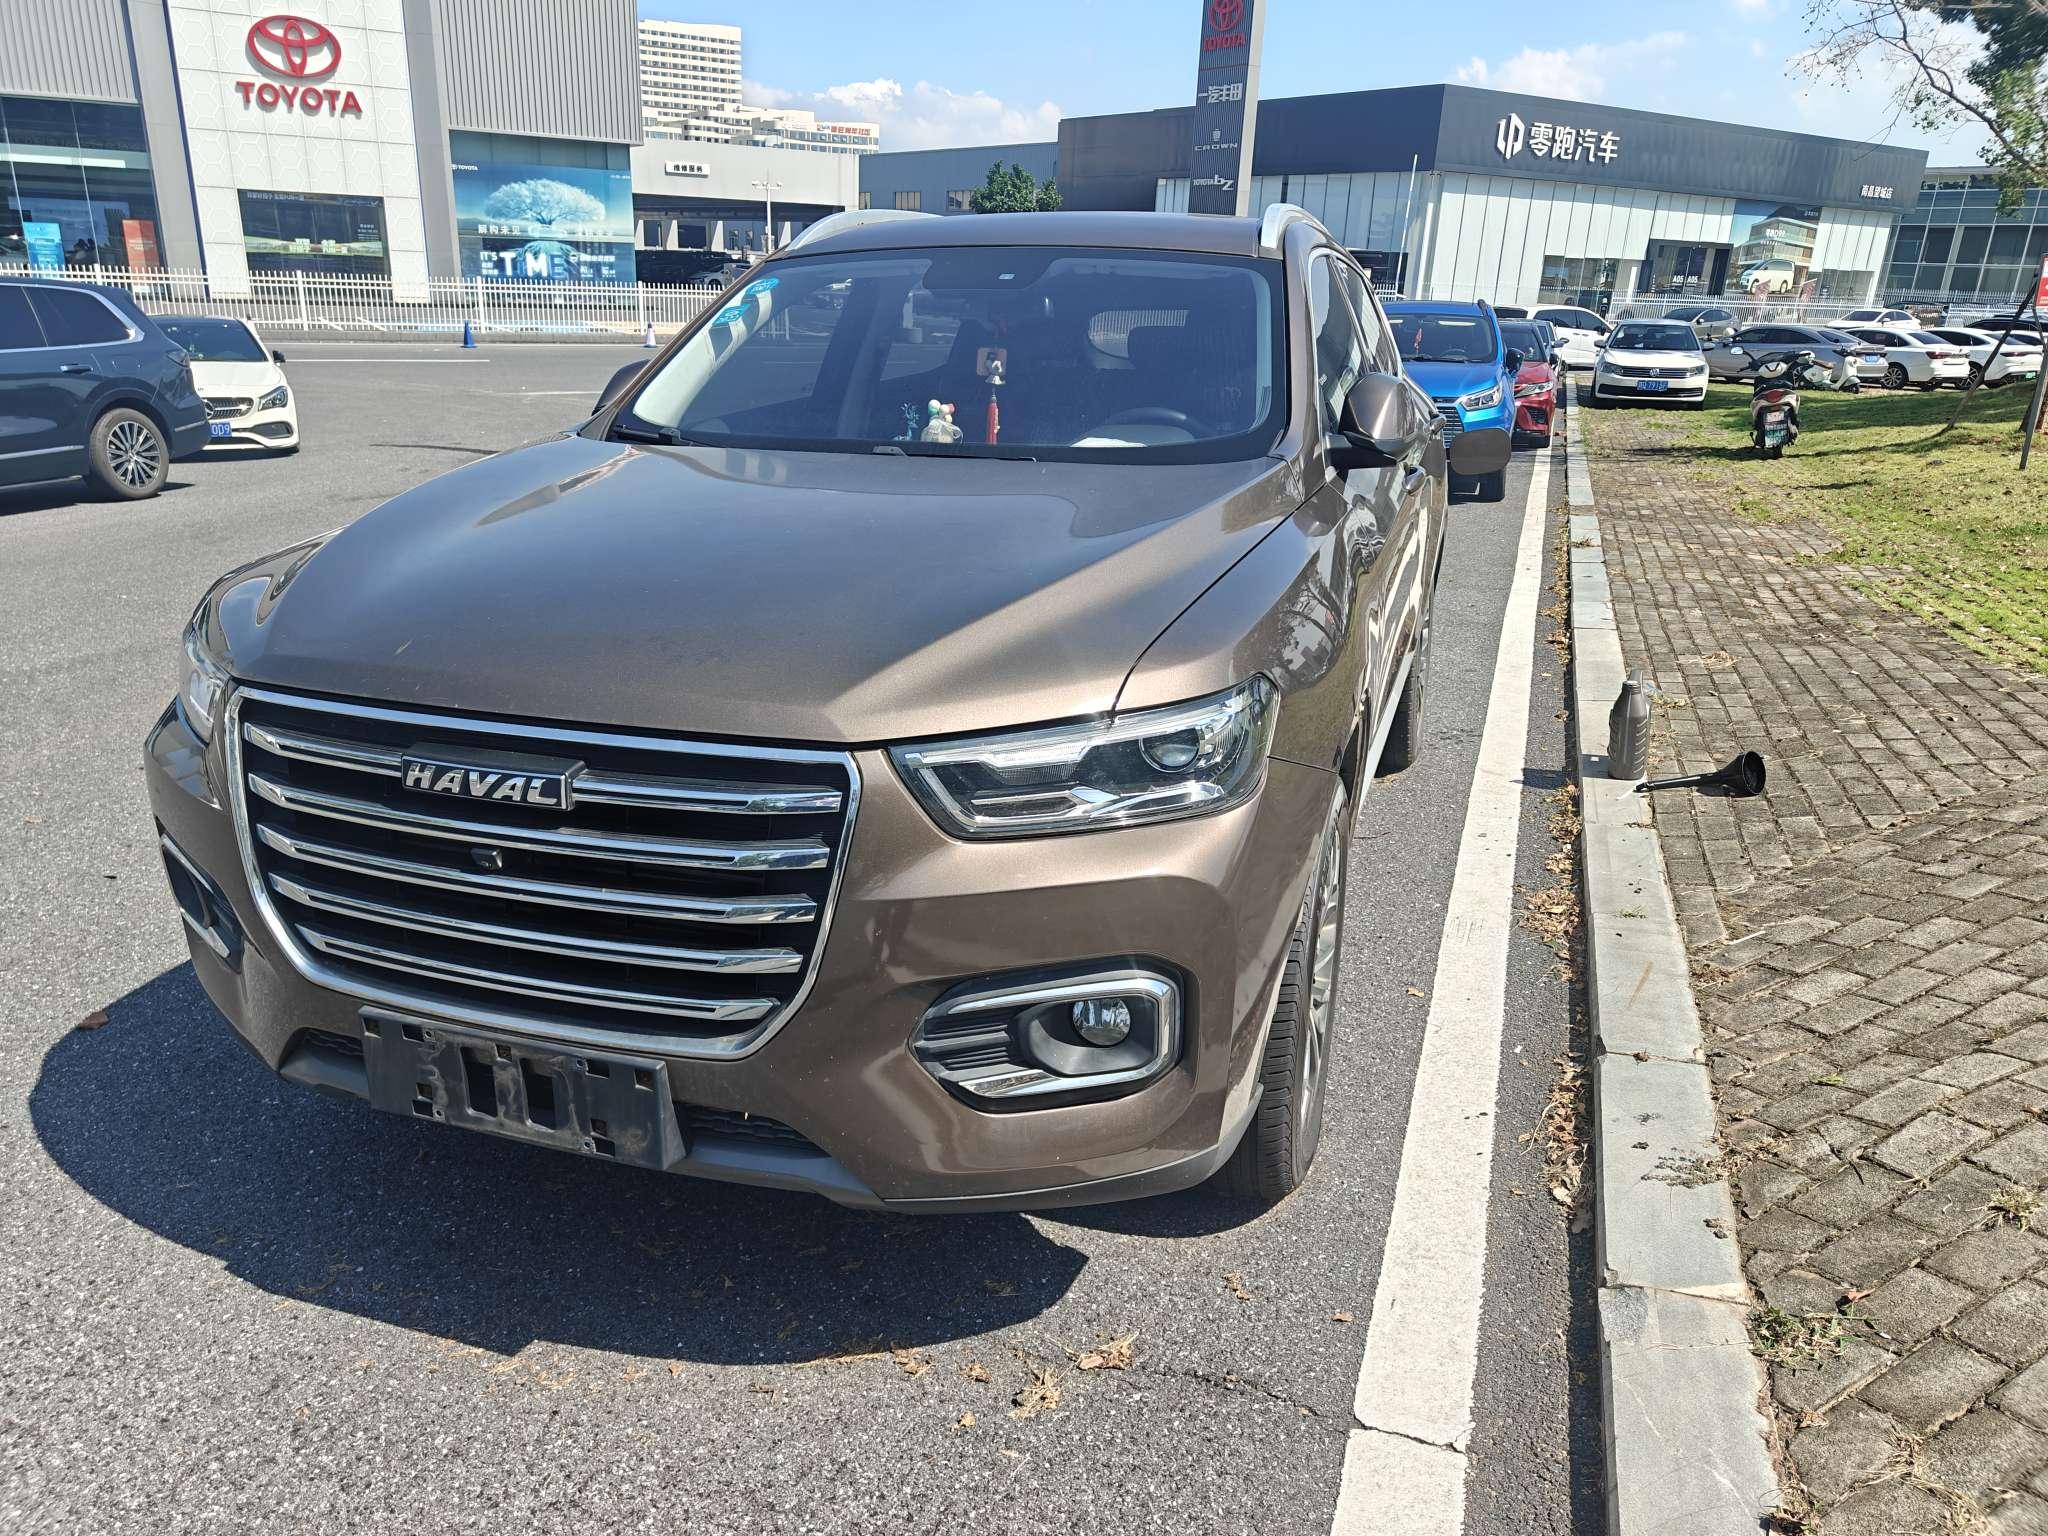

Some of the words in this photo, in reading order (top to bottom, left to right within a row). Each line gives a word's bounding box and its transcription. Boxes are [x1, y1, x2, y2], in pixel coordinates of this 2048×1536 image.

[1203, 32, 1246, 51] TOYOTA
[236, 80, 363, 116] TOYOTA
[1198, 82, 1243, 104] 一汽丰田
[1194, 142, 1238, 151] CROWN
[1528, 121, 1621, 164] 零跑汽车
[673, 163, 703, 173] 维修服务
[1193, 178, 1214, 186] TOYOTA
[404, 763, 559, 806] HAVAL
